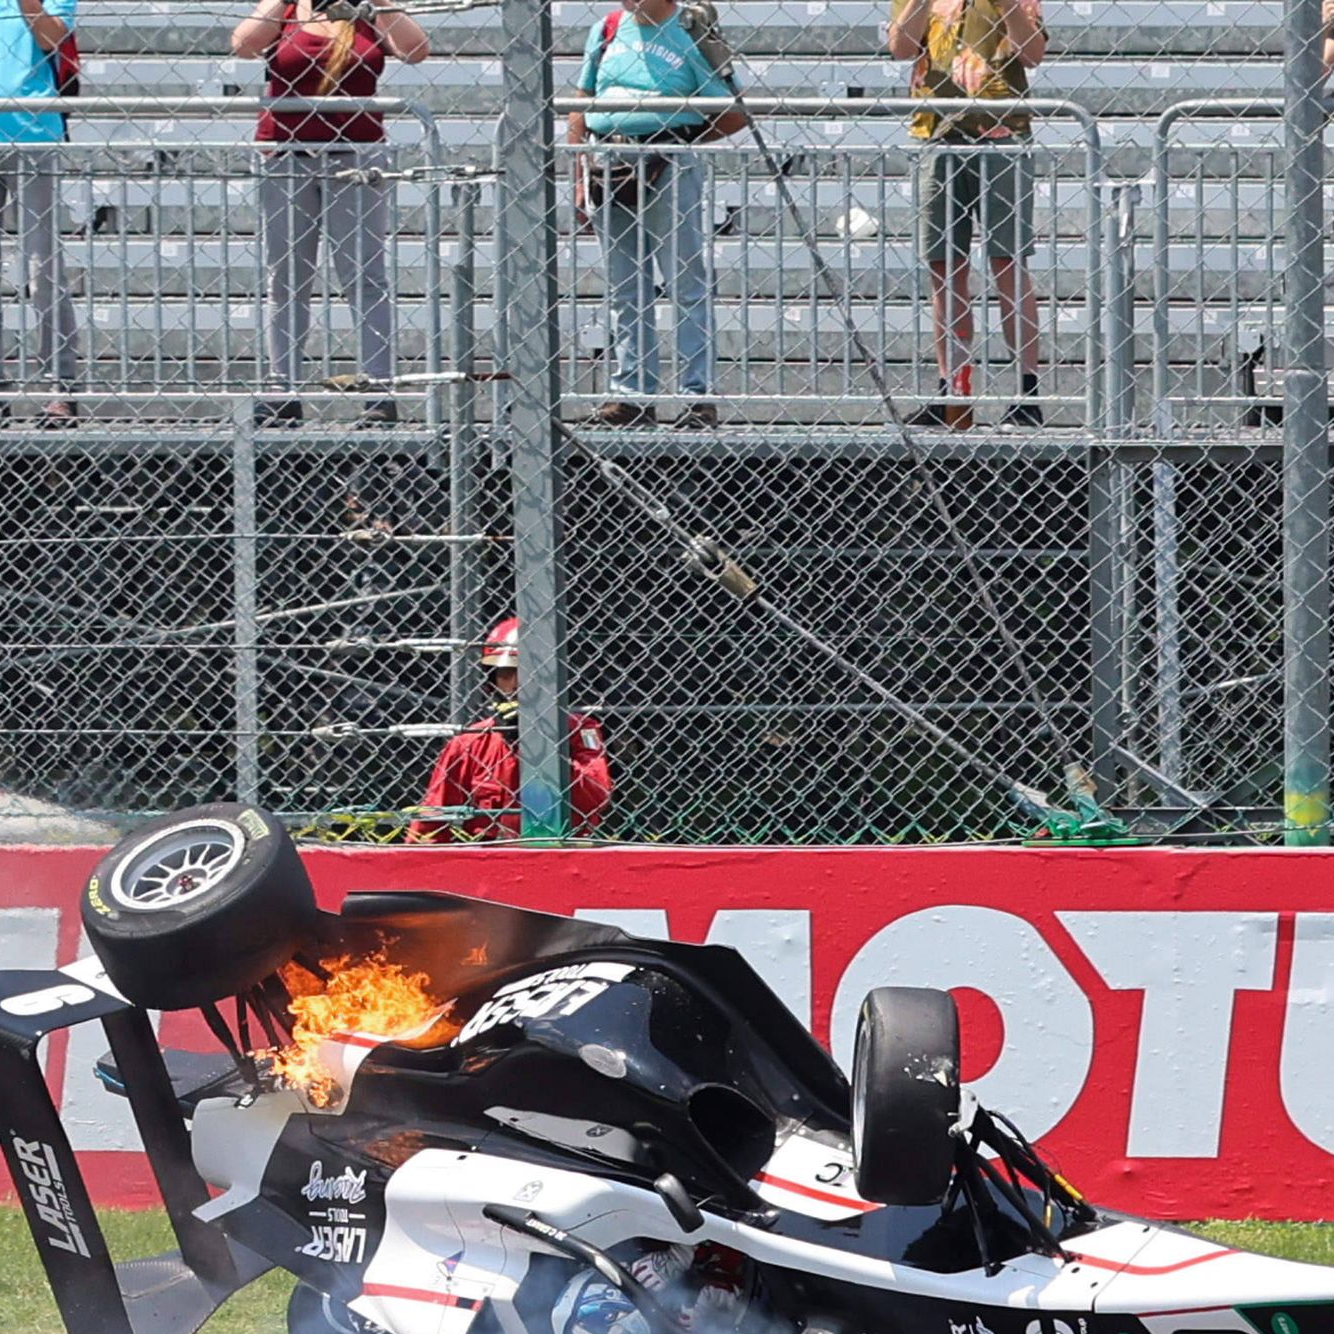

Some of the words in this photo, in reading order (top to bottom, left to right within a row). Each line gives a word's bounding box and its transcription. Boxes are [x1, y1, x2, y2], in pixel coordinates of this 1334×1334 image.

[88, 878, 111, 915] ZERO
[13, 1137, 78, 1254] LASER
[53, 1179, 77, 1223] TOOLS
[301, 1161, 367, 1204] Racing
[302, 1226, 367, 1264] LASER
